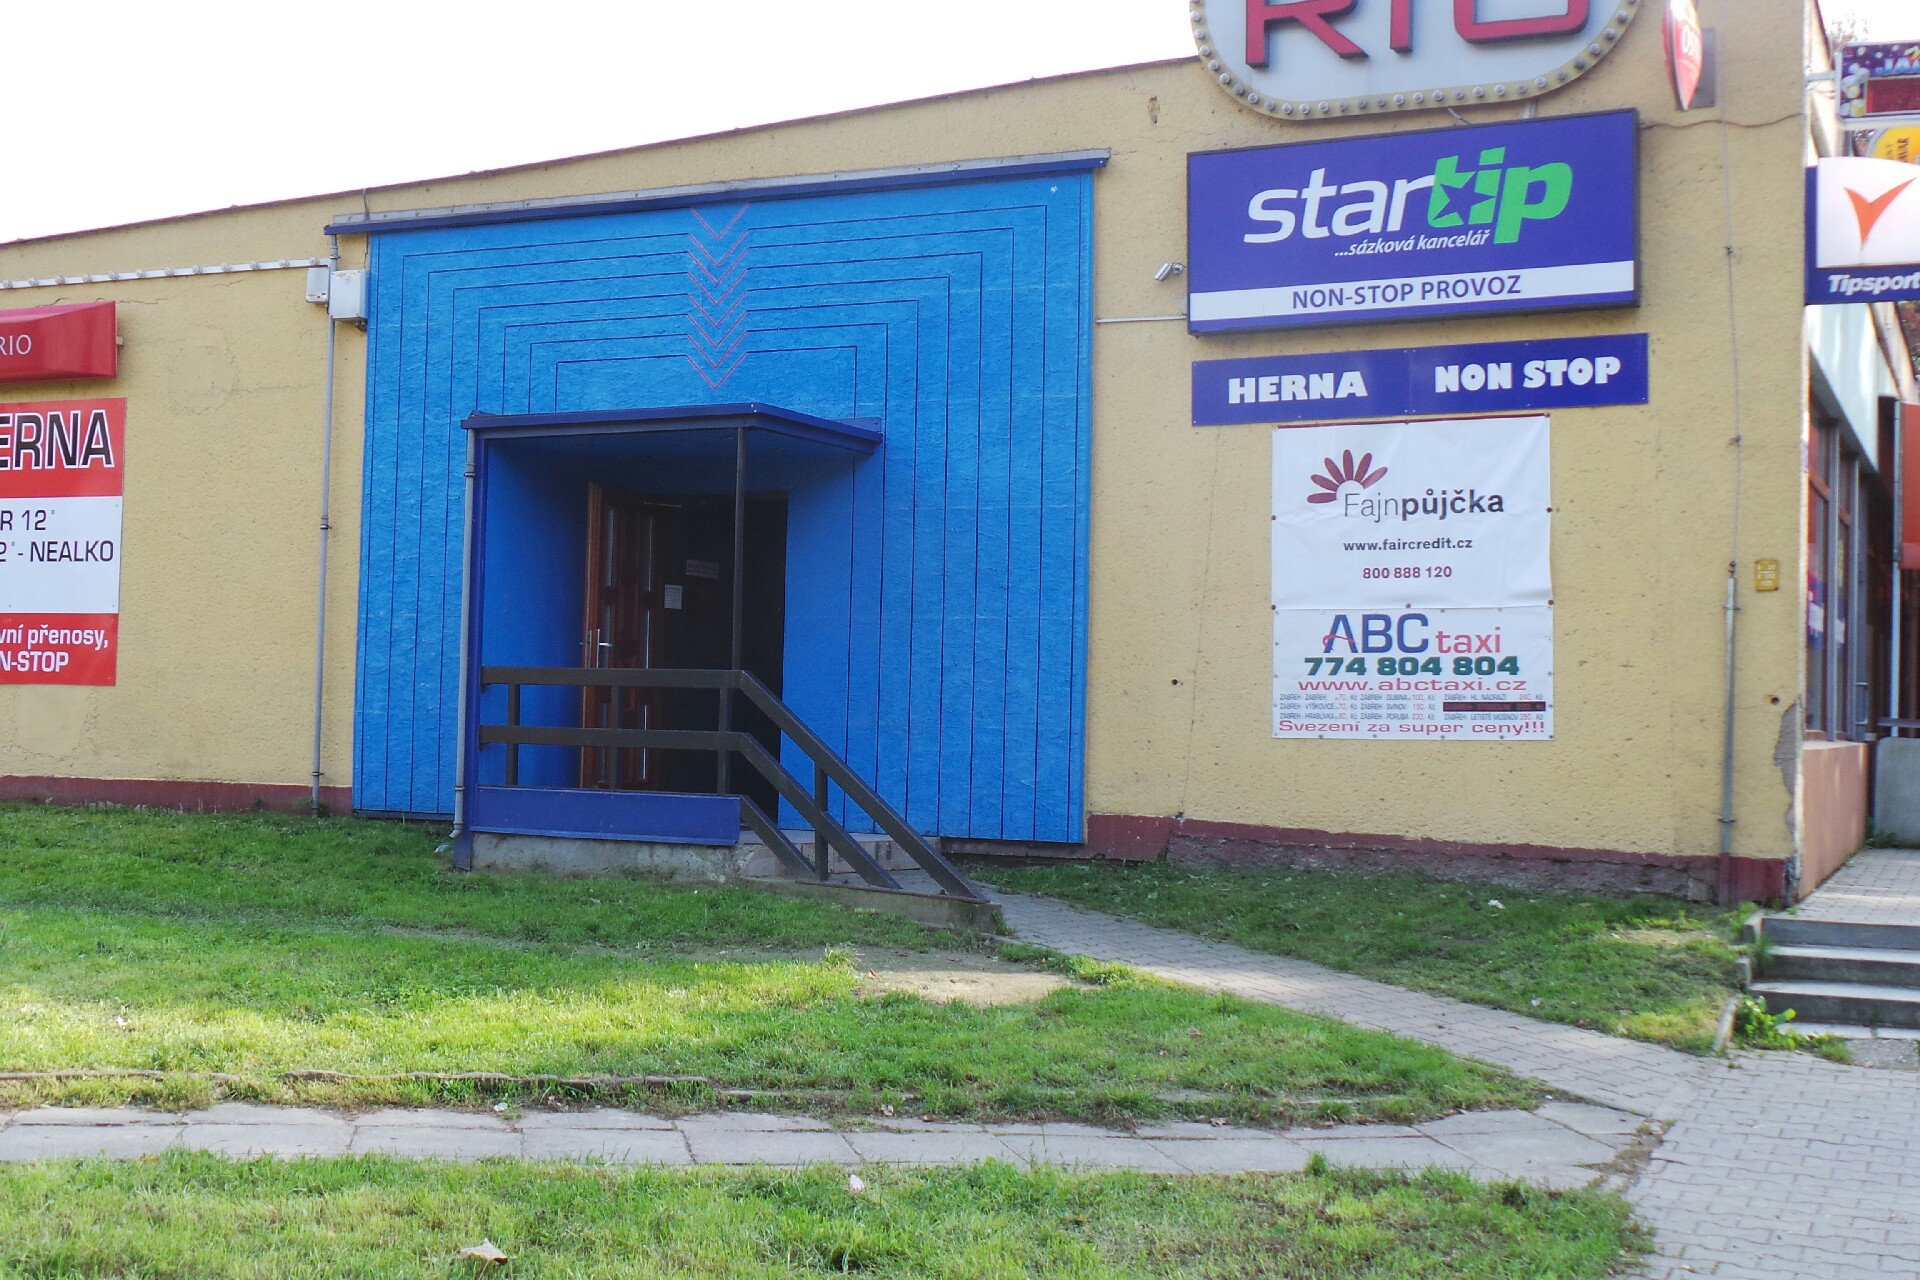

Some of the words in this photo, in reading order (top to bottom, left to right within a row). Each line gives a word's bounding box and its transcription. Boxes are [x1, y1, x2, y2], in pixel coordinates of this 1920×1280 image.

[1243, 146, 1574, 244] startip
[1417, 228, 1491, 252] kancelář
[1292, 282, 1413, 309] NON-STOP
[1420, 275, 1521, 301] PROVOZ
[1828, 272, 1920, 296] Tipsport
[1228, 371, 1368, 404] HERNA
[1435, 363, 1513, 394] NON
[1523, 356, 1621, 389] STOP
[30, 541, 114, 562] NEALKO
[1343, 537, 1473, 551] www.faircredit.cz
[1363, 567, 1390, 579] 800
[1394, 567, 1421, 579] 888
[1426, 566, 1452, 578] 120
[27, 624, 109, 651] přenosy,
[1322, 612, 1429, 654] ABC
[1436, 626, 1501, 654] taxi
[1304, 656, 1367, 676] 774
[1376, 656, 1442, 676] 804
[1452, 656, 1520, 676] 804
[1298, 677, 1527, 691] www.abctaxi.cz
[1279, 720, 1361, 732] Svezení
[1367, 723, 1390, 732] za
[1399, 722, 1464, 736] super
[1472, 721, 1545, 736] ceny!!!
